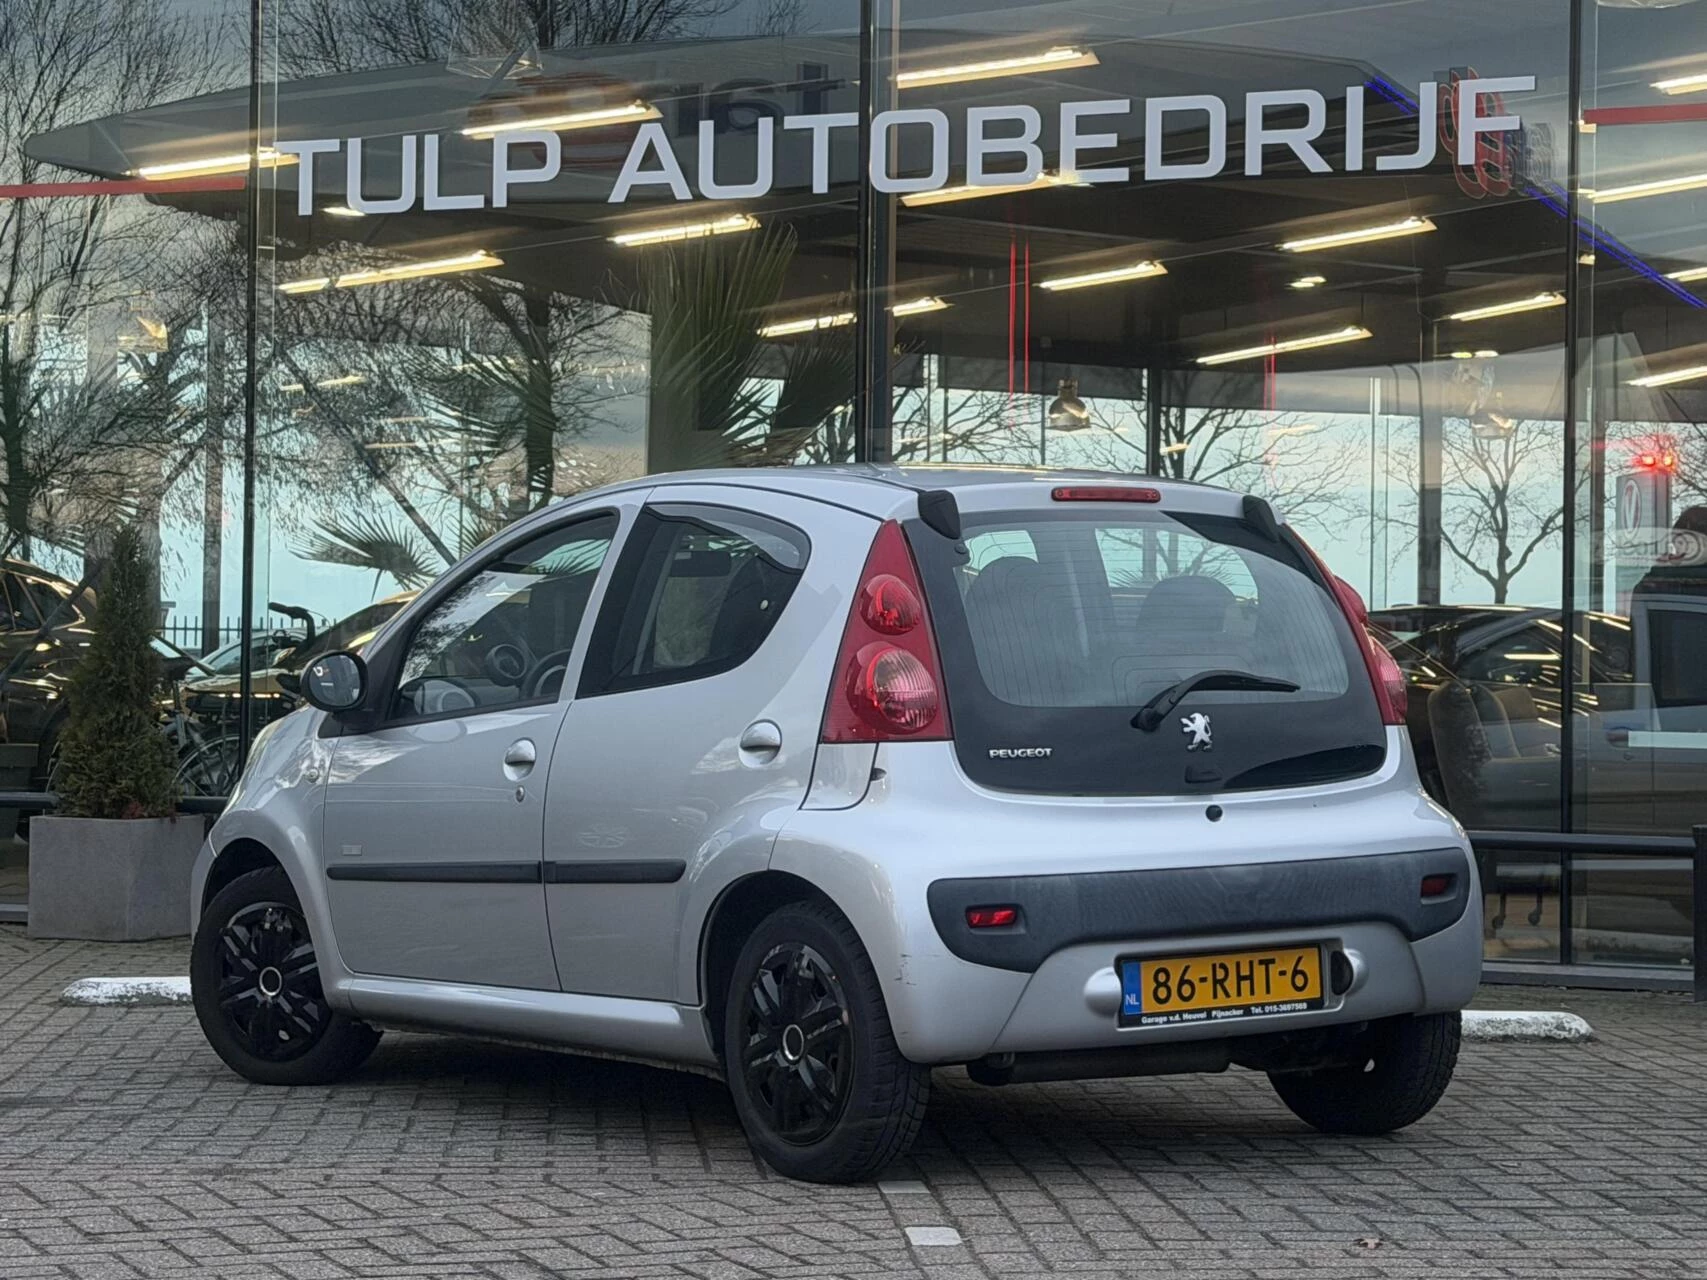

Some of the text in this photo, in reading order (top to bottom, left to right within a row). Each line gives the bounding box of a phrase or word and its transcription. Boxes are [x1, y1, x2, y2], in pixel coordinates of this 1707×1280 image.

[272, 128, 562, 216] TULP
[607, 75, 1537, 204] AUTOBEDRIJF
[988, 747, 1052, 758] PEUGEOT
[1152, 955, 1309, 1005] 86-RHT-6
[1125, 993, 1139, 1006] NL
[1141, 1015, 1168, 1024] Garage
[1211, 1009, 1244, 1019] Pijnacker
